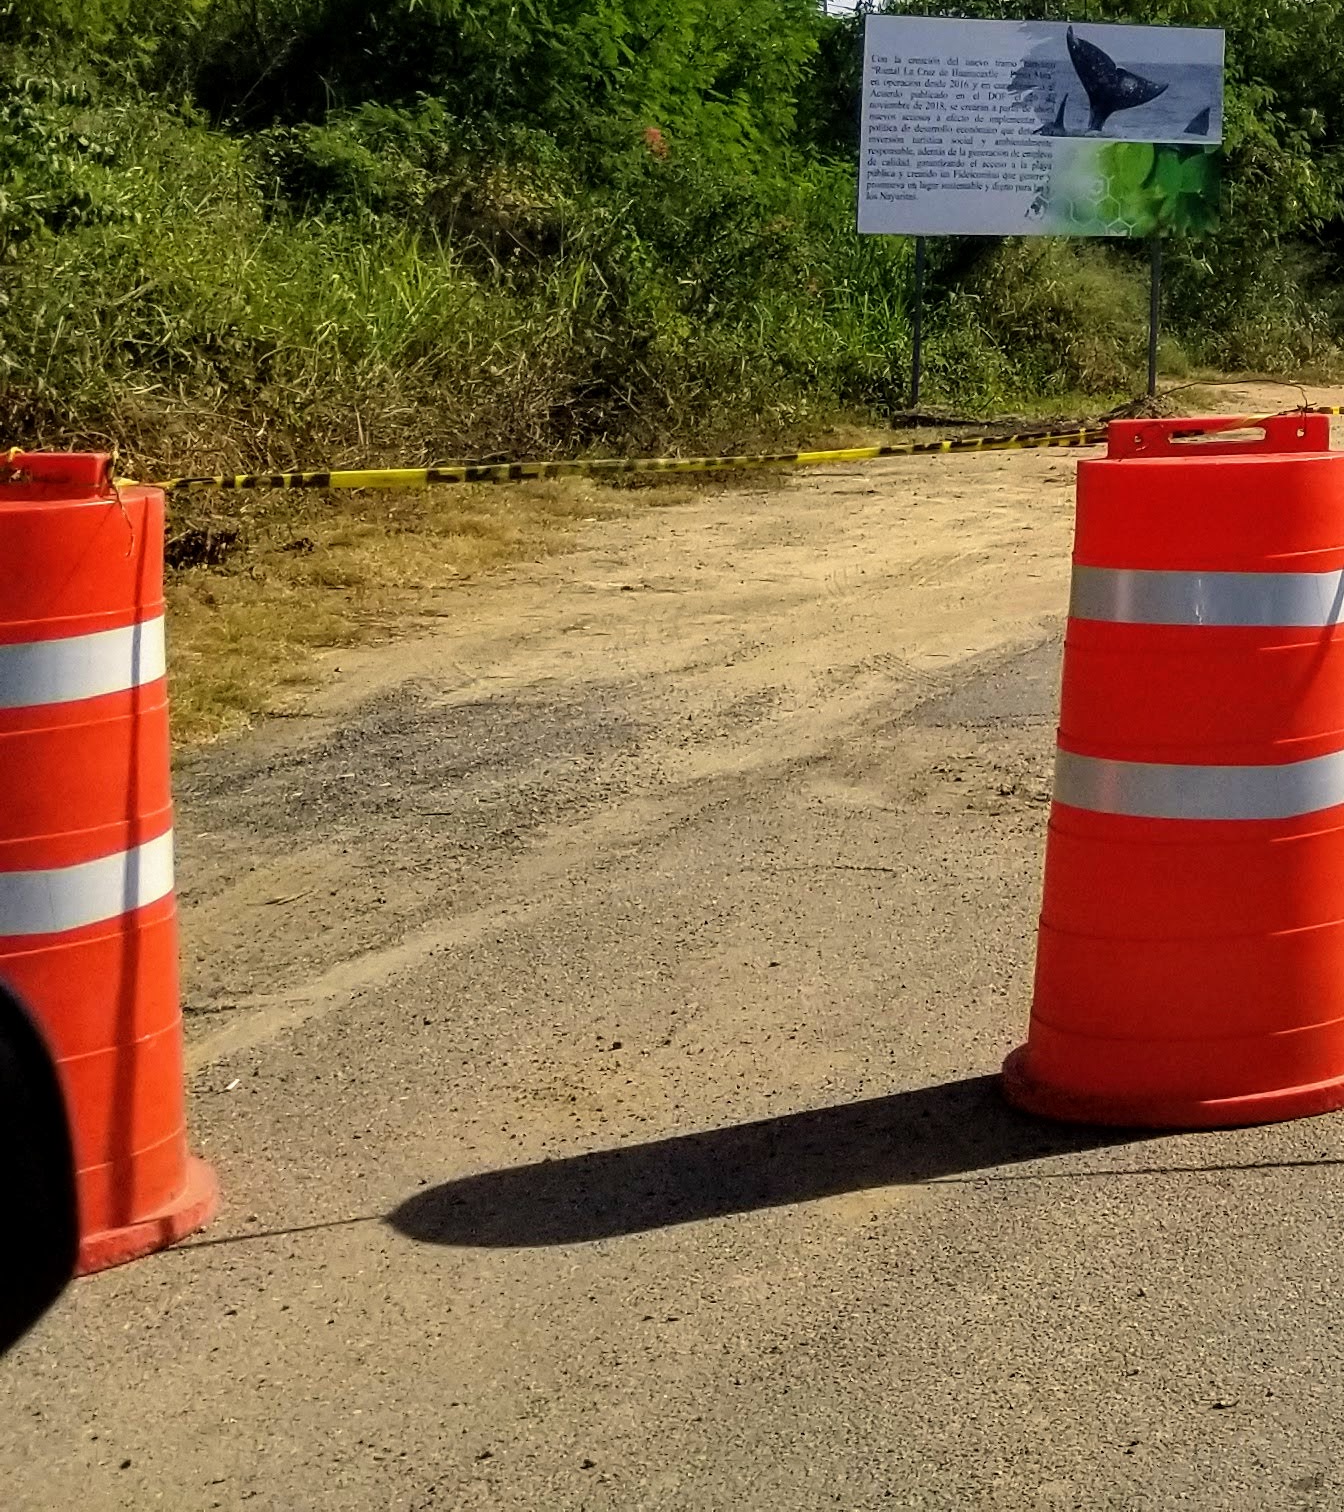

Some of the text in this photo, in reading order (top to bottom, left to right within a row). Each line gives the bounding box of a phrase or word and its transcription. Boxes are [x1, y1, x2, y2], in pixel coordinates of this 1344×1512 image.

[871, 54, 887, 63] Con
[947, 57, 958, 65] del
[903, 67, 913, 75] La
[917, 67, 935, 76] Cruz
[939, 68, 949, 76] de
[913, 101, 922, 110] de
[975, 114, 984, 122] de
[901, 124, 911, 132] de
[947, 147, 957, 155] de
[959, 146, 966, 156] la
[867, 157, 877, 166] de
[1031, 160, 1052, 171] playa
